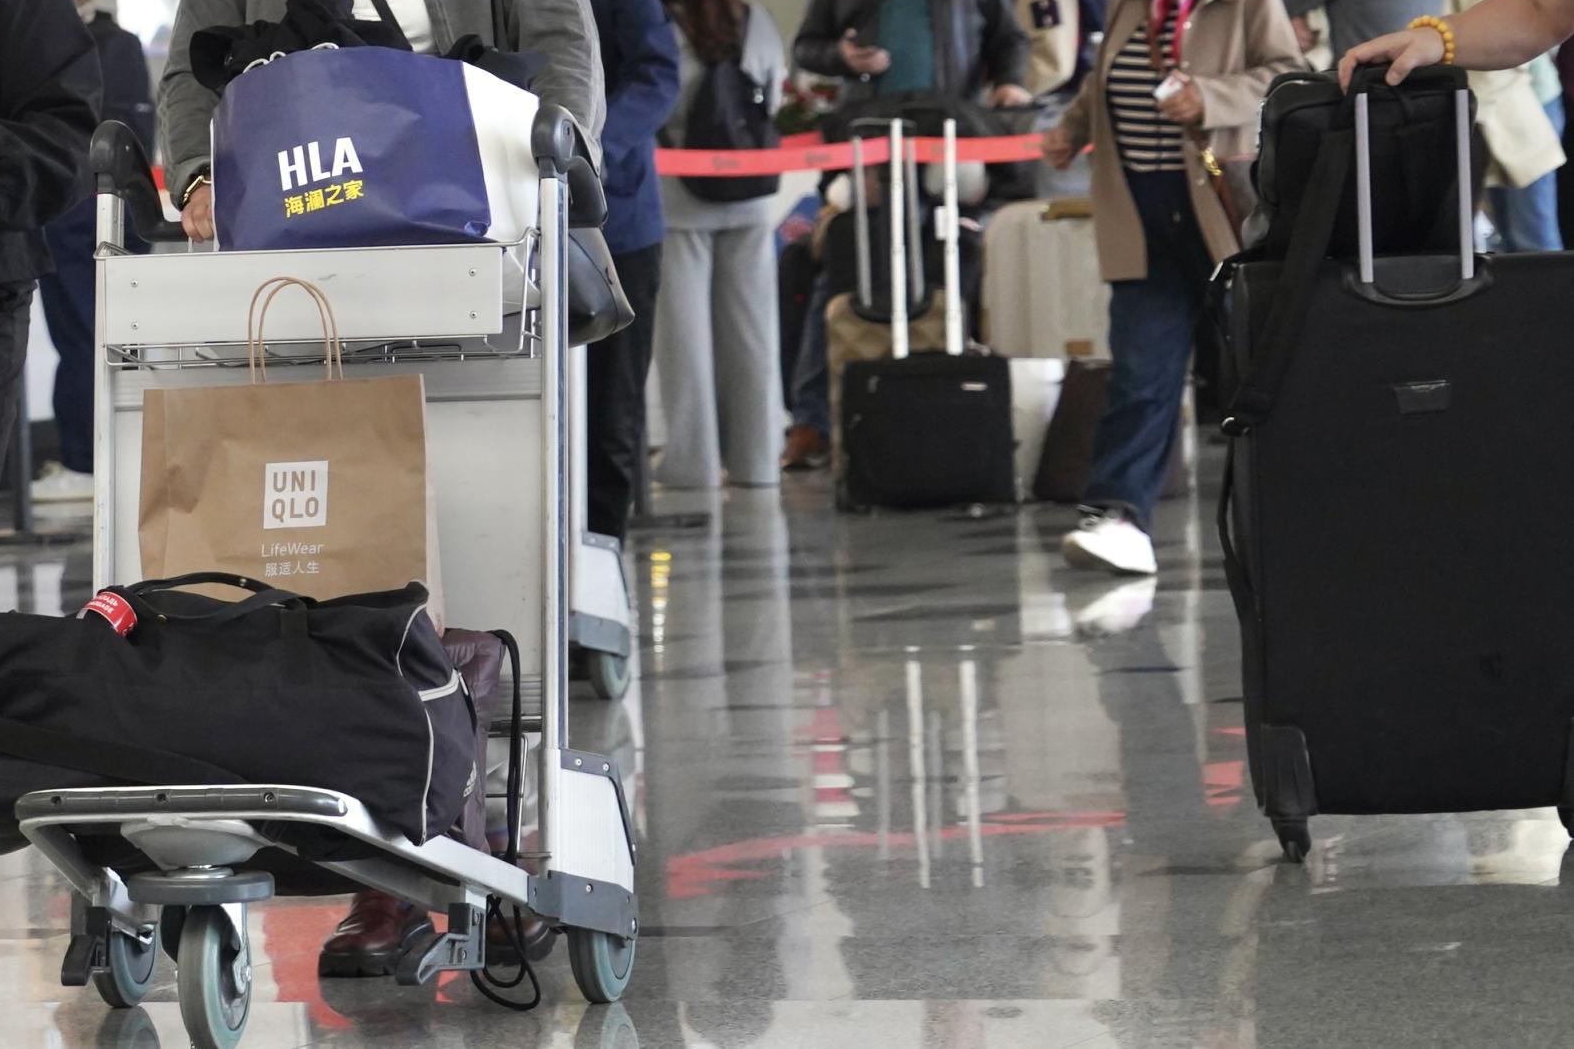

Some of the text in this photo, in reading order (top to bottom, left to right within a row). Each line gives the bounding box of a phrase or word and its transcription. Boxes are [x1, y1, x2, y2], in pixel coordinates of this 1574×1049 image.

[277, 137, 364, 191] HLA
[284, 179, 364, 218] 海澜之家
[273, 470, 316, 493] UNI
[271, 497, 319, 523] QLO
[261, 543, 324, 558] LifeWear
[264, 561, 320, 577] 服适人生
